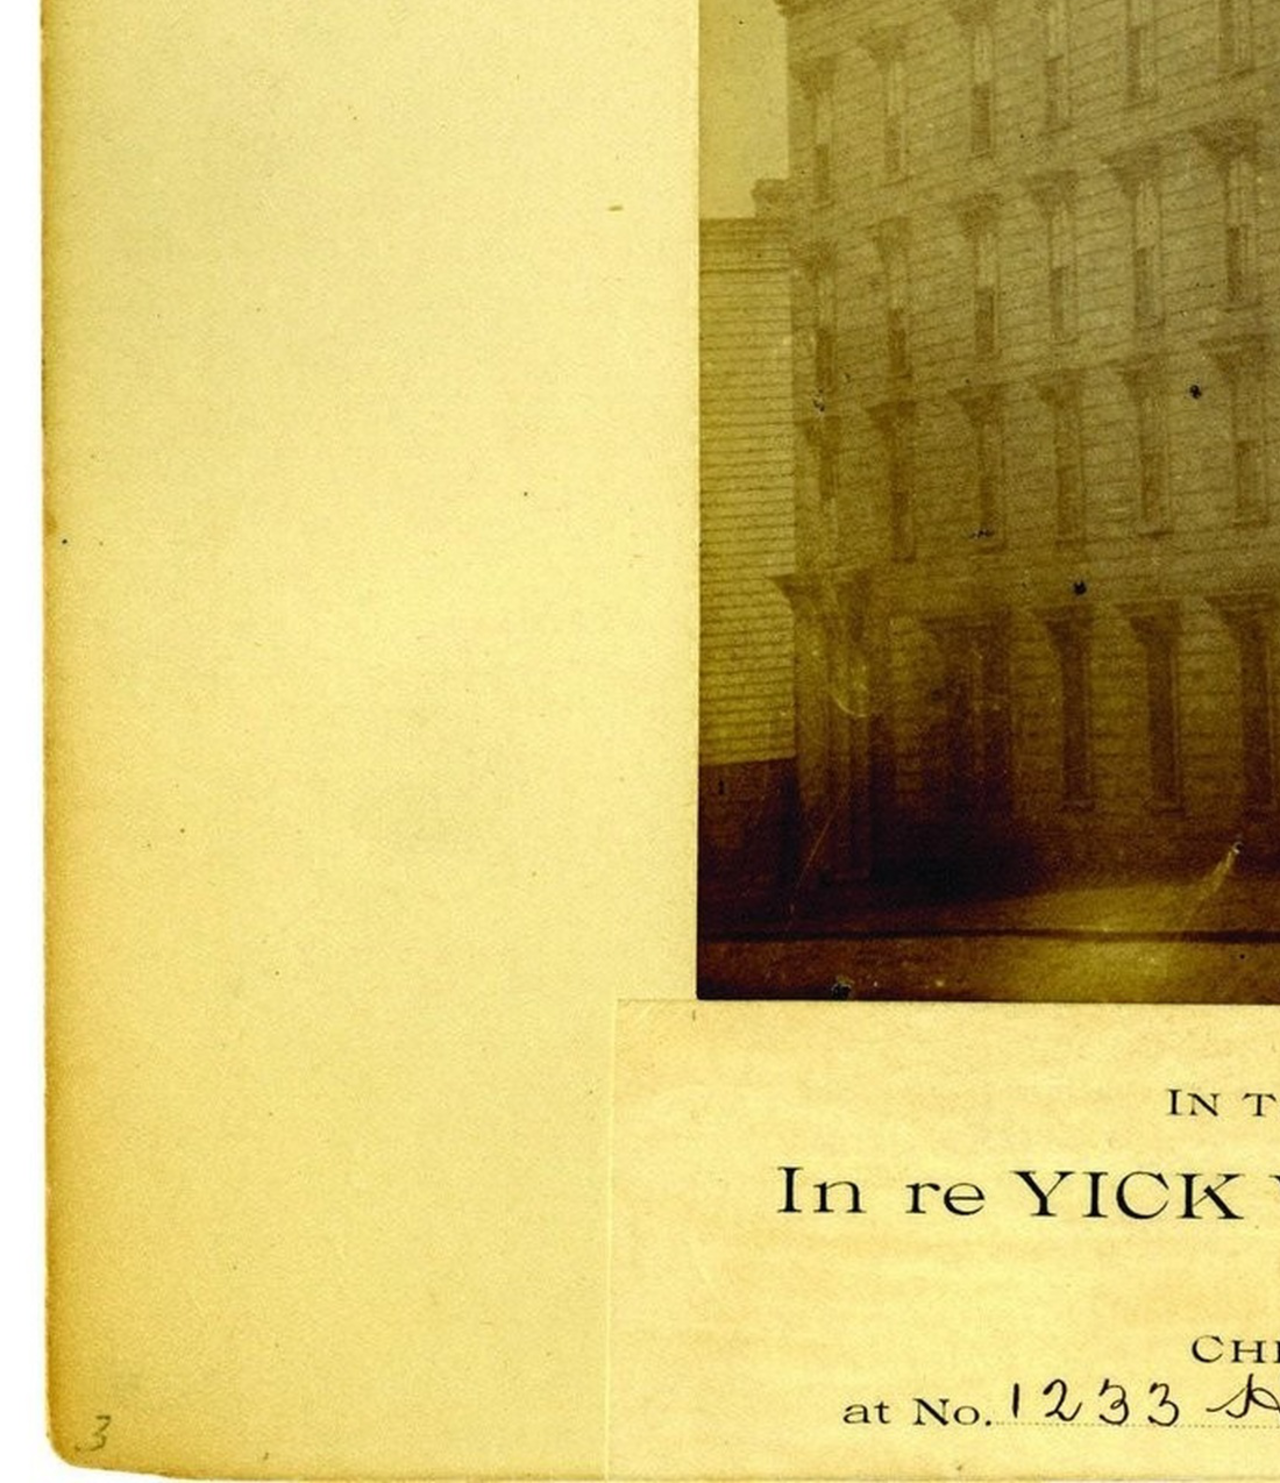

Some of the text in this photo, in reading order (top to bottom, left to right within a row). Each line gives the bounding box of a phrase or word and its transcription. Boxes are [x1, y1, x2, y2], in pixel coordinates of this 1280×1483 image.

[1167, 1089, 1220, 1117] IN
[777, 1166, 866, 1213] In
[906, 1183, 985, 1216] re
[1011, 1170, 1245, 1220] YICK
[843, 1401, 890, 1424] at
[913, 1398, 992, 1426] No.
[1012, 1378, 1179, 1427] 1233
